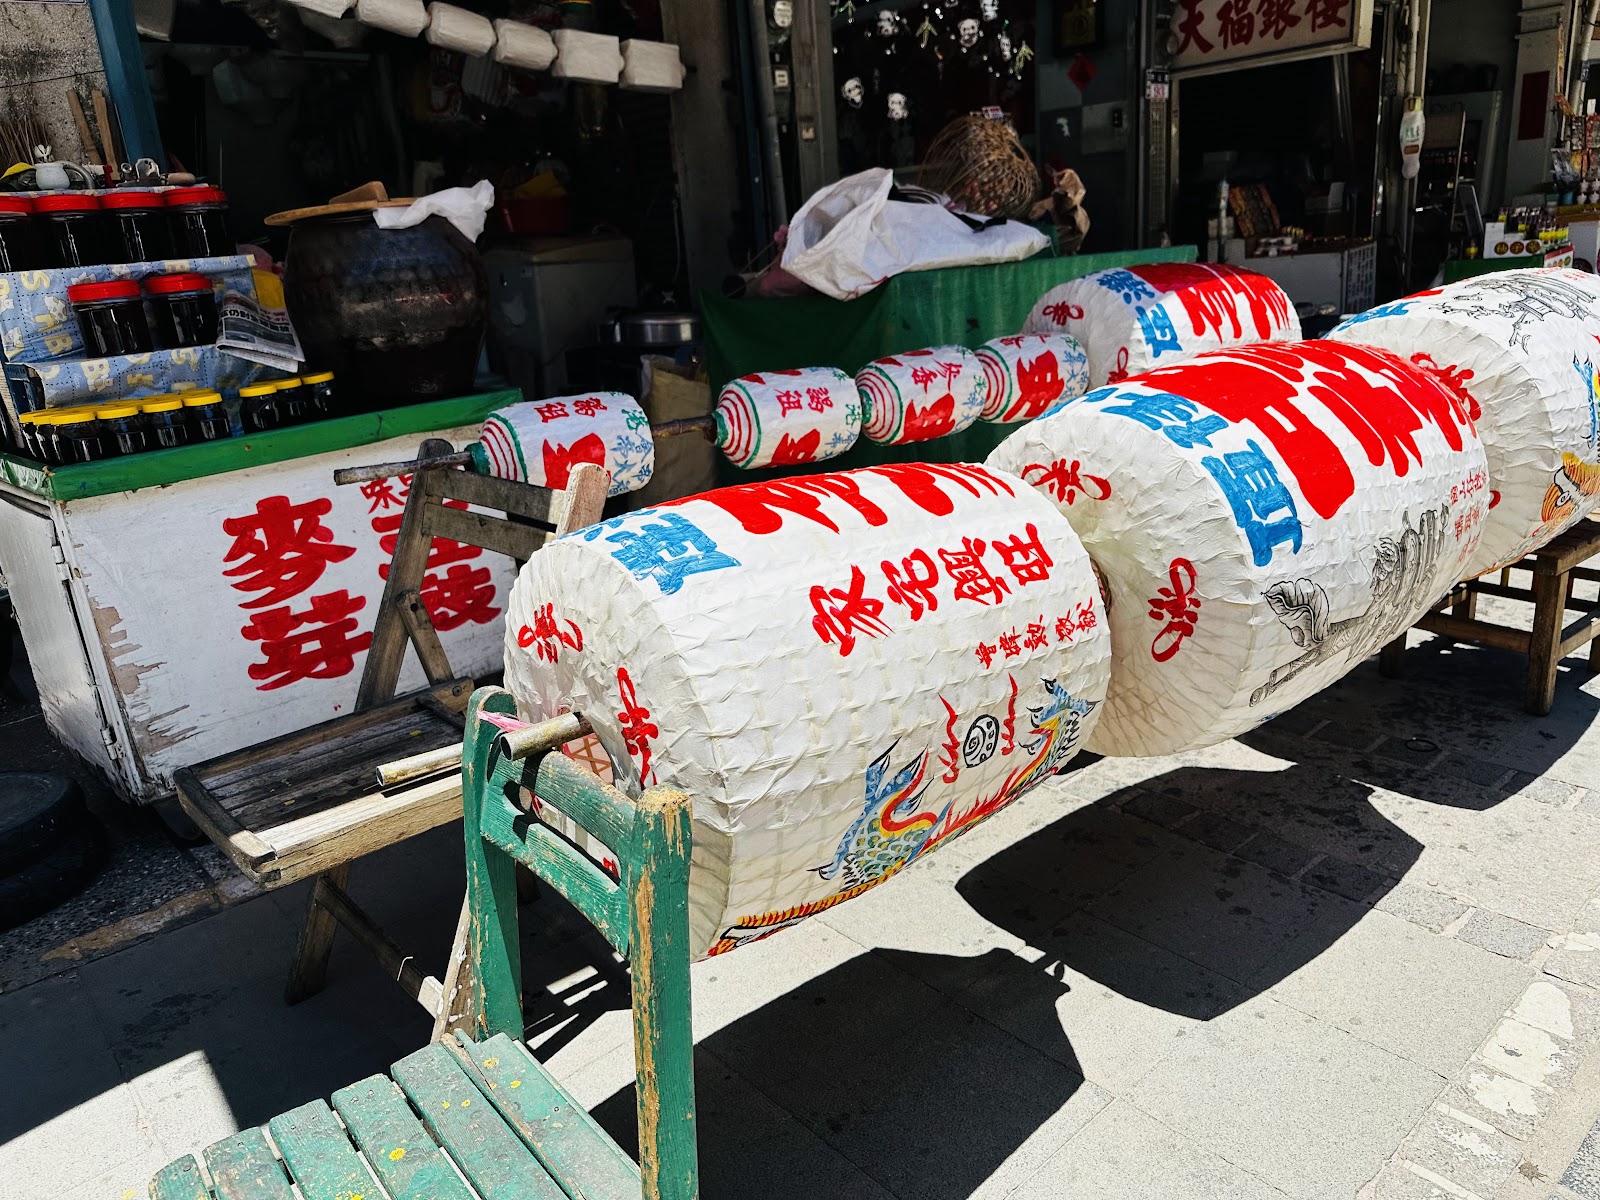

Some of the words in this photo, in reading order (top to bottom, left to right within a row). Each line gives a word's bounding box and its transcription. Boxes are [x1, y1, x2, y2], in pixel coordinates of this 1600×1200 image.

[222, 495, 374, 691] 麥芽
[808, 522, 1055, 658] 家宅興旺
